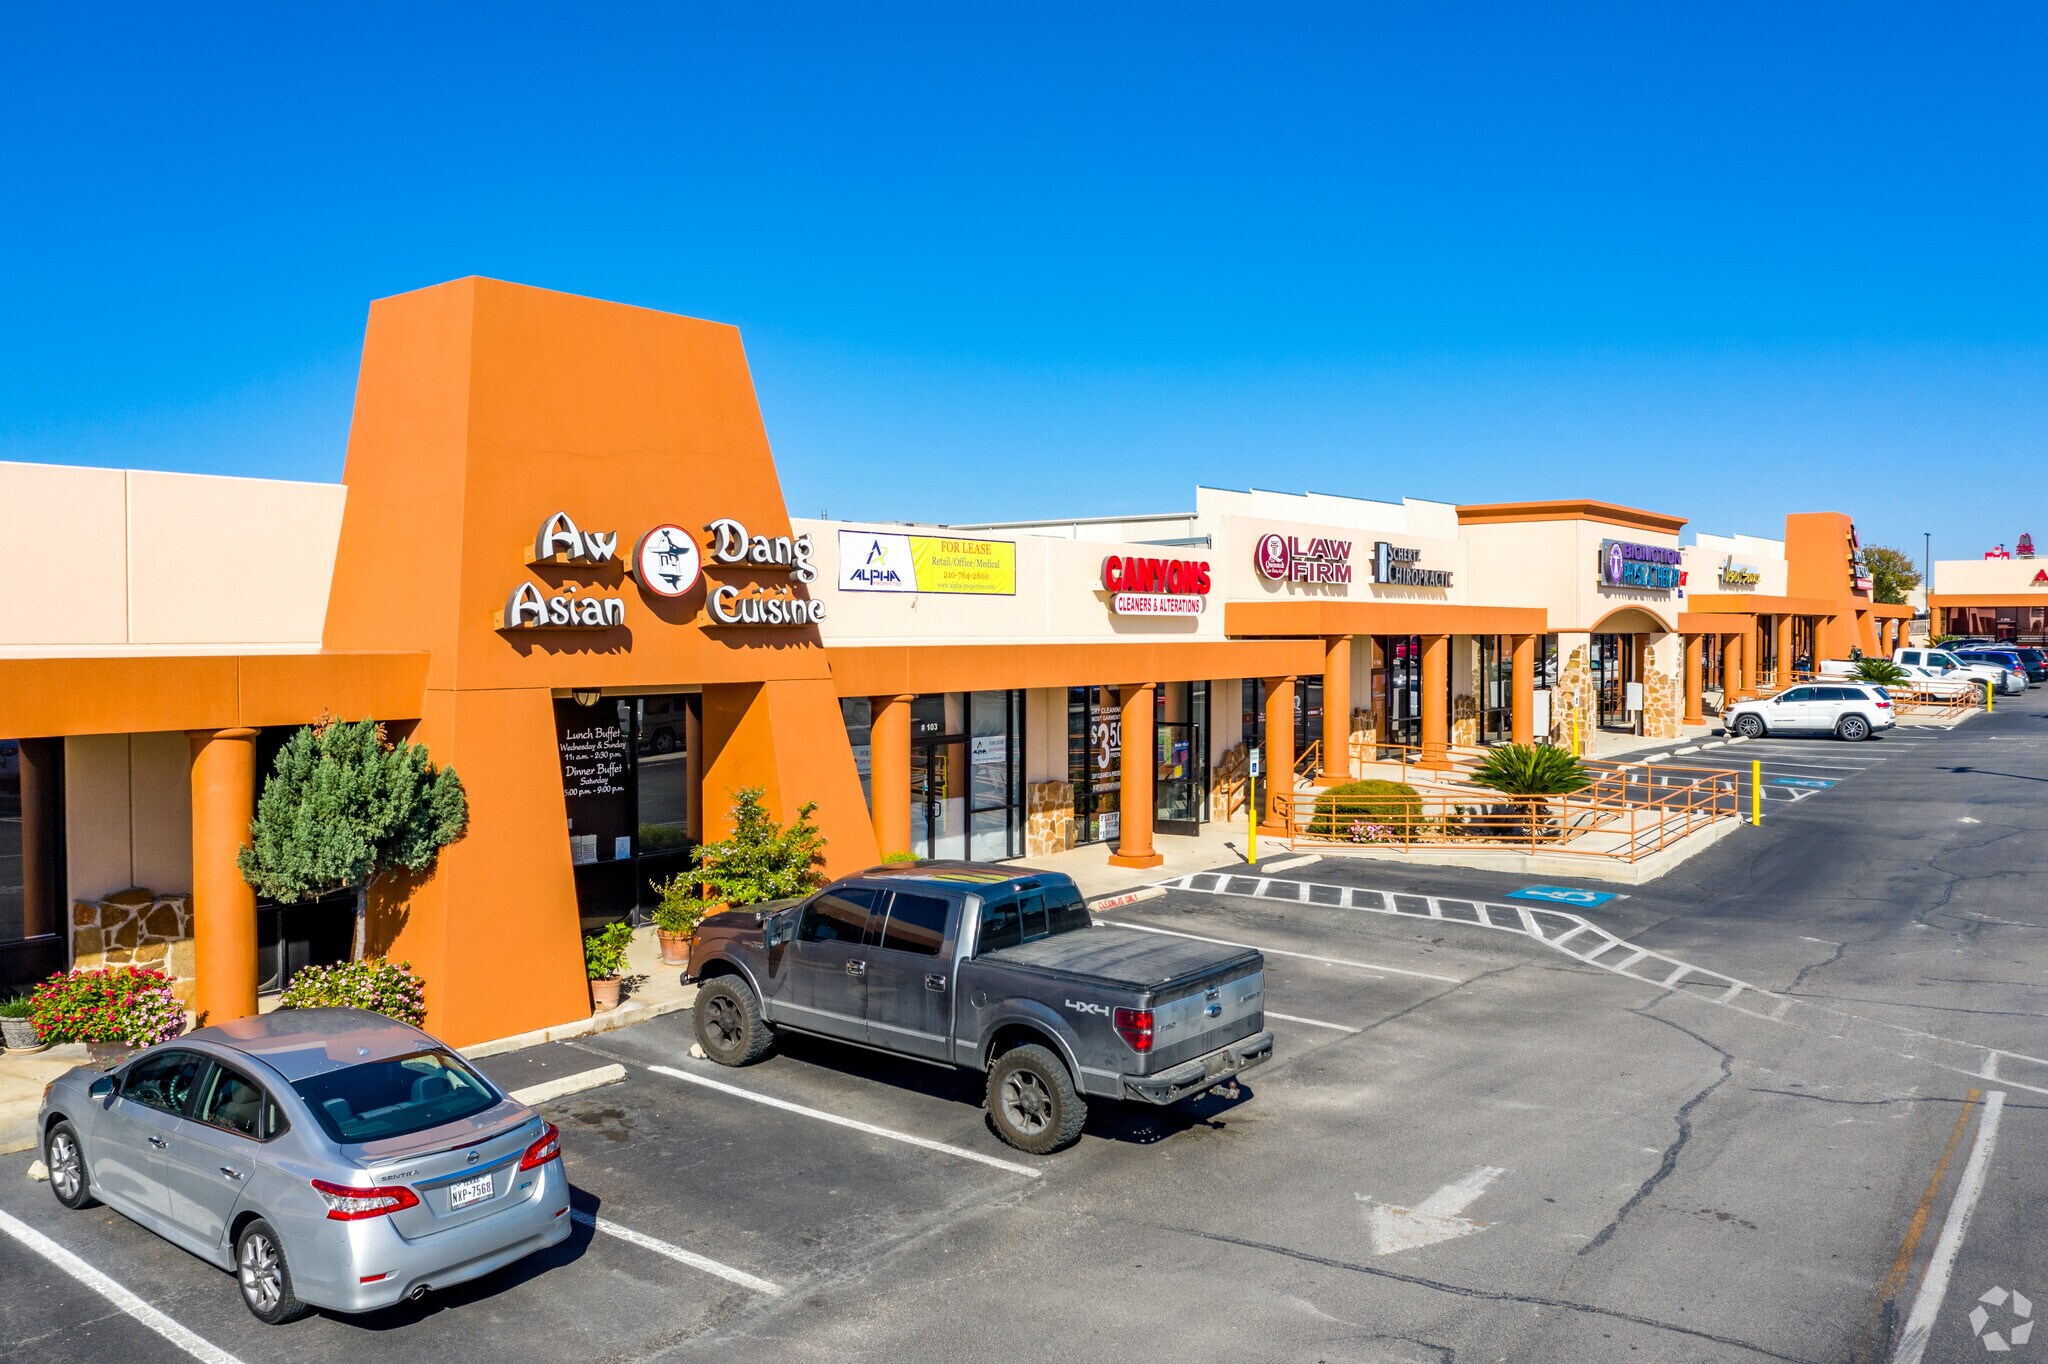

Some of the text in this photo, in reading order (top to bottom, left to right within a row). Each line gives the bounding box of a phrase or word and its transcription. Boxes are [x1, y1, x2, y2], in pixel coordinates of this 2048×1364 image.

[537, 511, 819, 583] Aw Dang
[941, 541, 992, 555] FOR LEASE
[1290, 536, 1352, 560] LAW
[1623, 543, 1682, 565] BIOMOTION
[850, 569, 901, 586] ALPHA
[943, 571, 990, 581] 210-764-2600
[1104, 555, 1211, 594] CANYONS
[1290, 560, 1351, 583] FIRM
[505, 581, 827, 627] Asian Cuisine
[1118, 597, 1200, 613] CLEANERS & ALTERATIONS
[566, 726, 621, 741] Lunch Buffet
[926, 723, 938, 731] 103
[560, 740, 627, 752] Wednesday & Sunday
[594, 751, 609, 759] 2:30
[565, 762, 622, 777] Dinner Buffet
[580, 775, 608, 785] Saturday
[597, 785, 611, 794] 9:00
[1065, 999, 1110, 1017] 4X4
[381, 1170, 420, 1181] SENTRA
